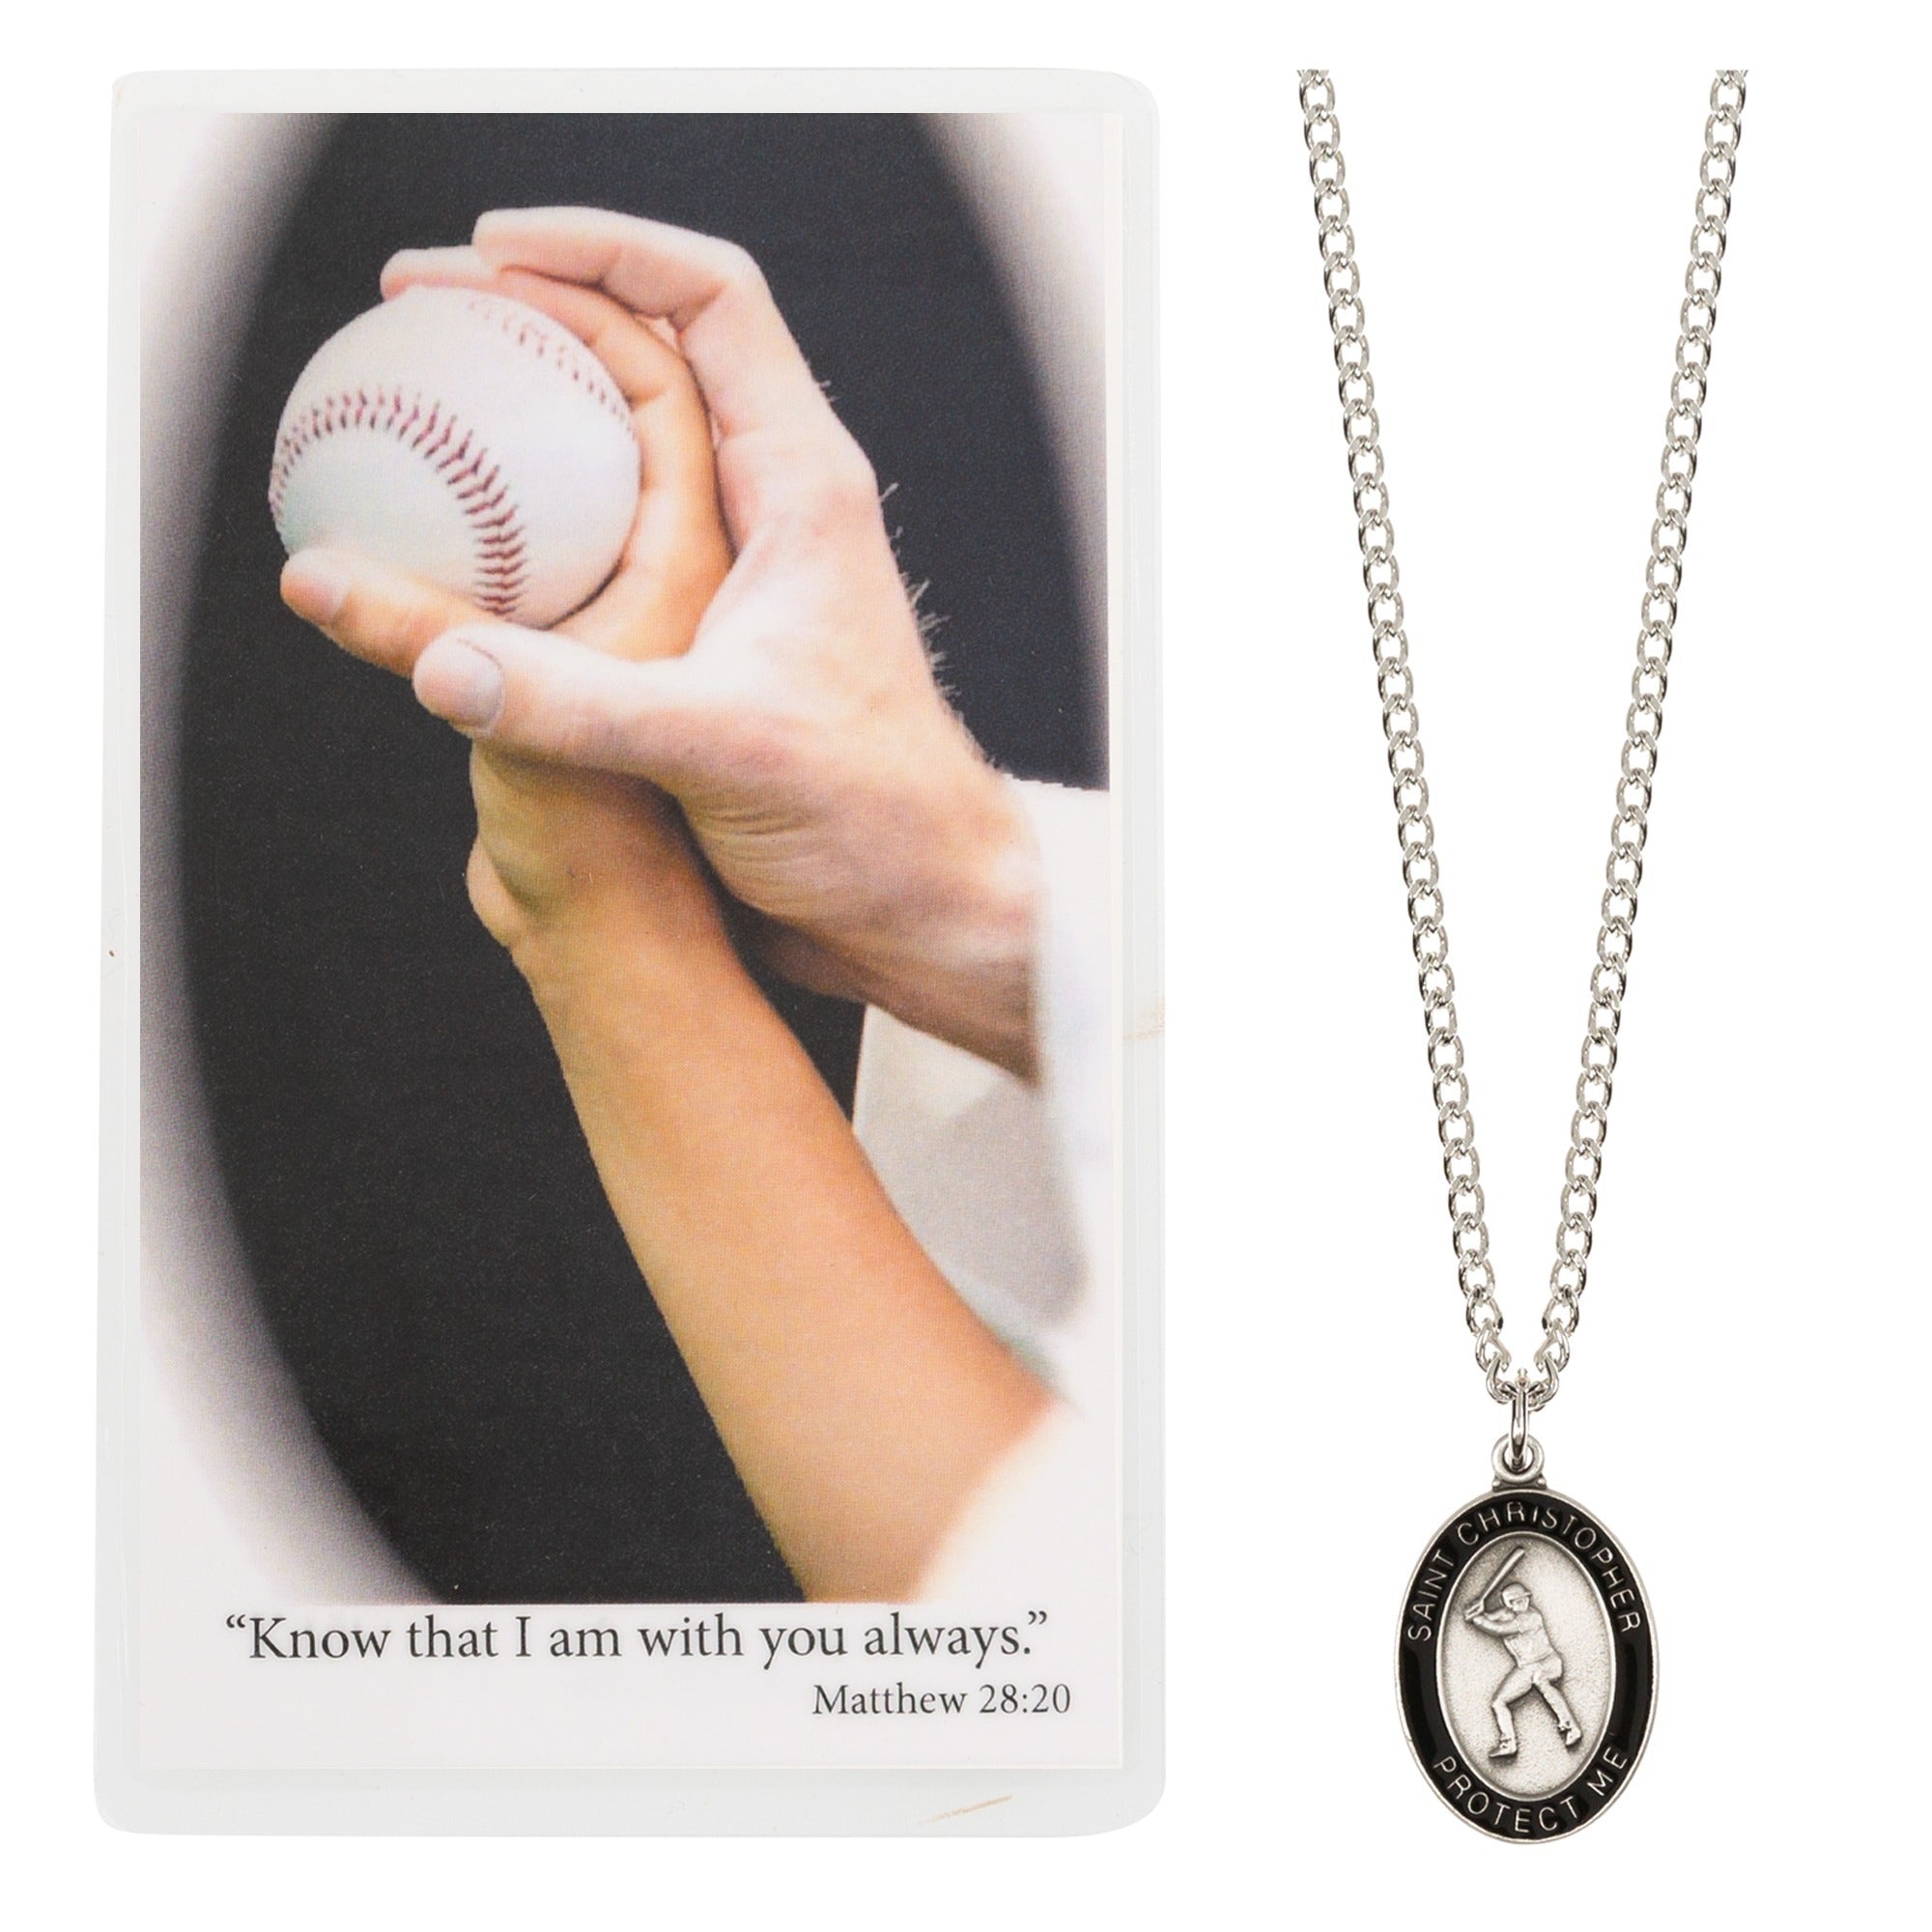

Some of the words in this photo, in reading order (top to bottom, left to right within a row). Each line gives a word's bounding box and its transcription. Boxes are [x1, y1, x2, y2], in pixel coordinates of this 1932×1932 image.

[1407, 1549, 1454, 1642] SAINT
[1457, 1501, 1641, 1634] CHRISTOPHER
[225, 1613, 391, 1659] “Know
[406, 1613, 498, 1658] that
[515, 1616, 531, 1658] I
[550, 1628, 622, 1658] am
[637, 1612, 744, 1658] with
[759, 1627, 848, 1667] you
[865, 1610, 1047, 1667] always.”
[812, 1681, 967, 1715] Matthew
[980, 1684, 1070, 1714] 28:20
[1434, 1755, 1578, 1833] PROTECT
[1587, 1746, 1629, 1797] ME
